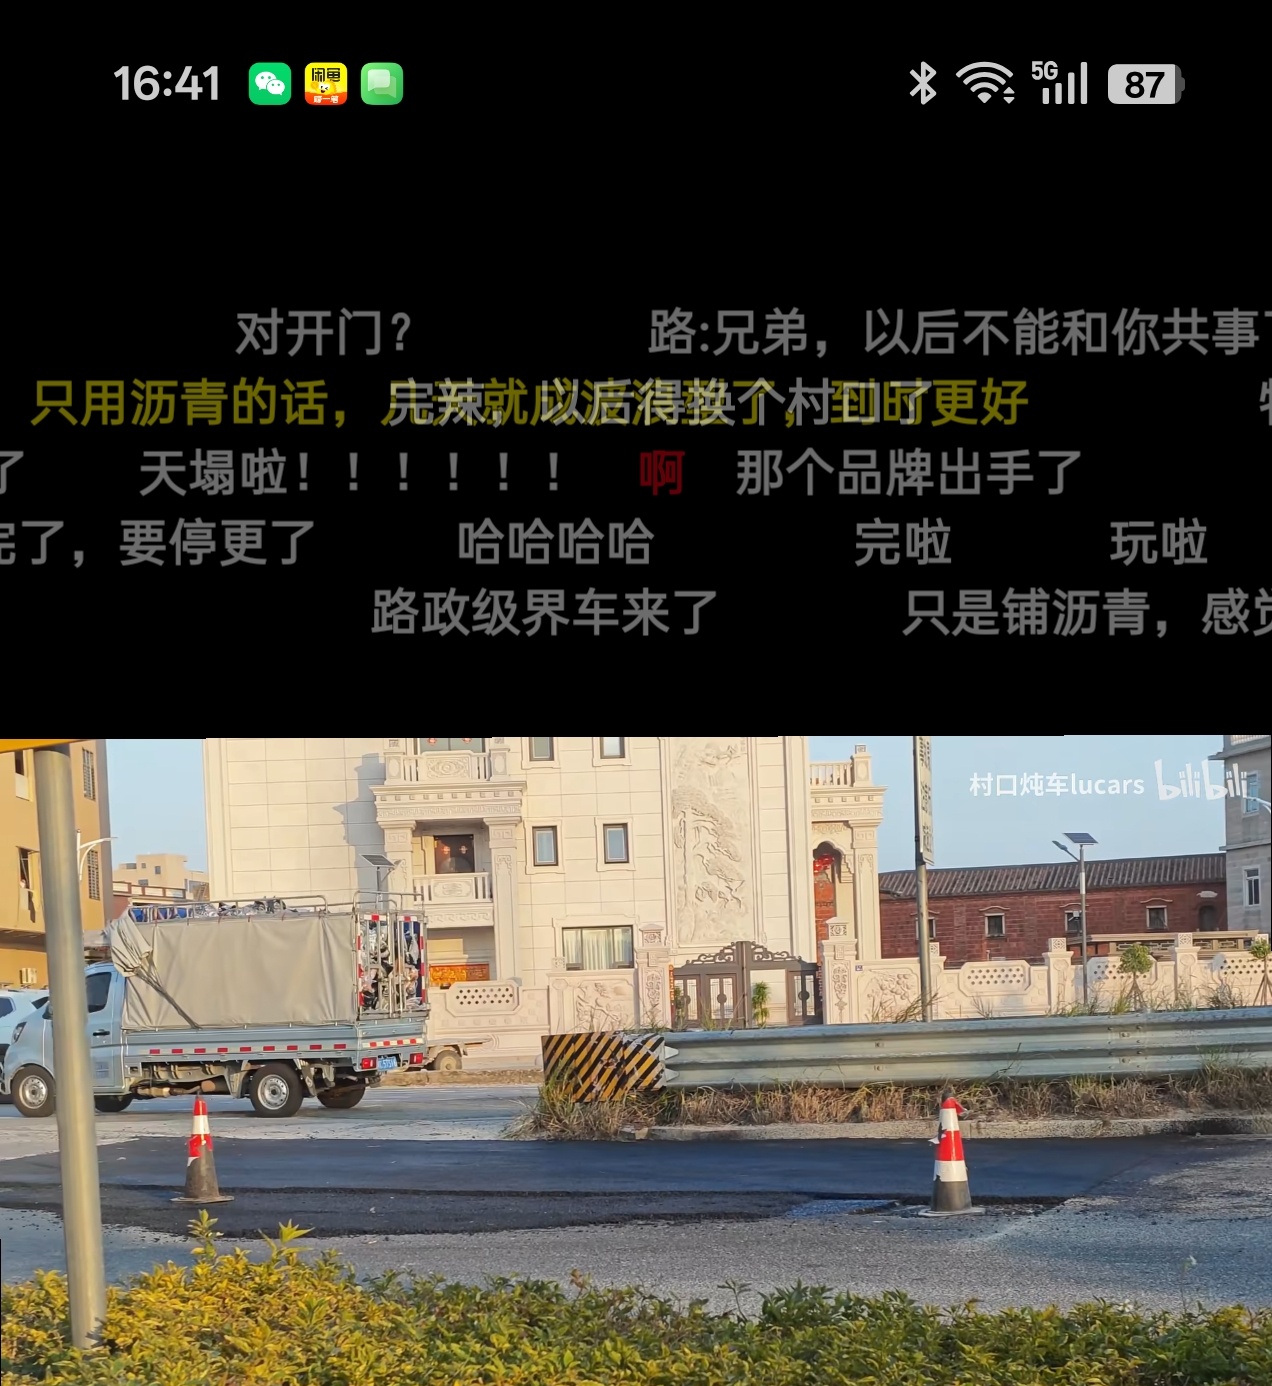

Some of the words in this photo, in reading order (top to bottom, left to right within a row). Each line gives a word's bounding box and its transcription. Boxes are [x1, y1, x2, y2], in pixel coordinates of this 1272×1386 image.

[114, 66, 218, 101] 16:41
[1031, 61, 1058, 80] 5G
[1125, 72, 1166, 98] 87
